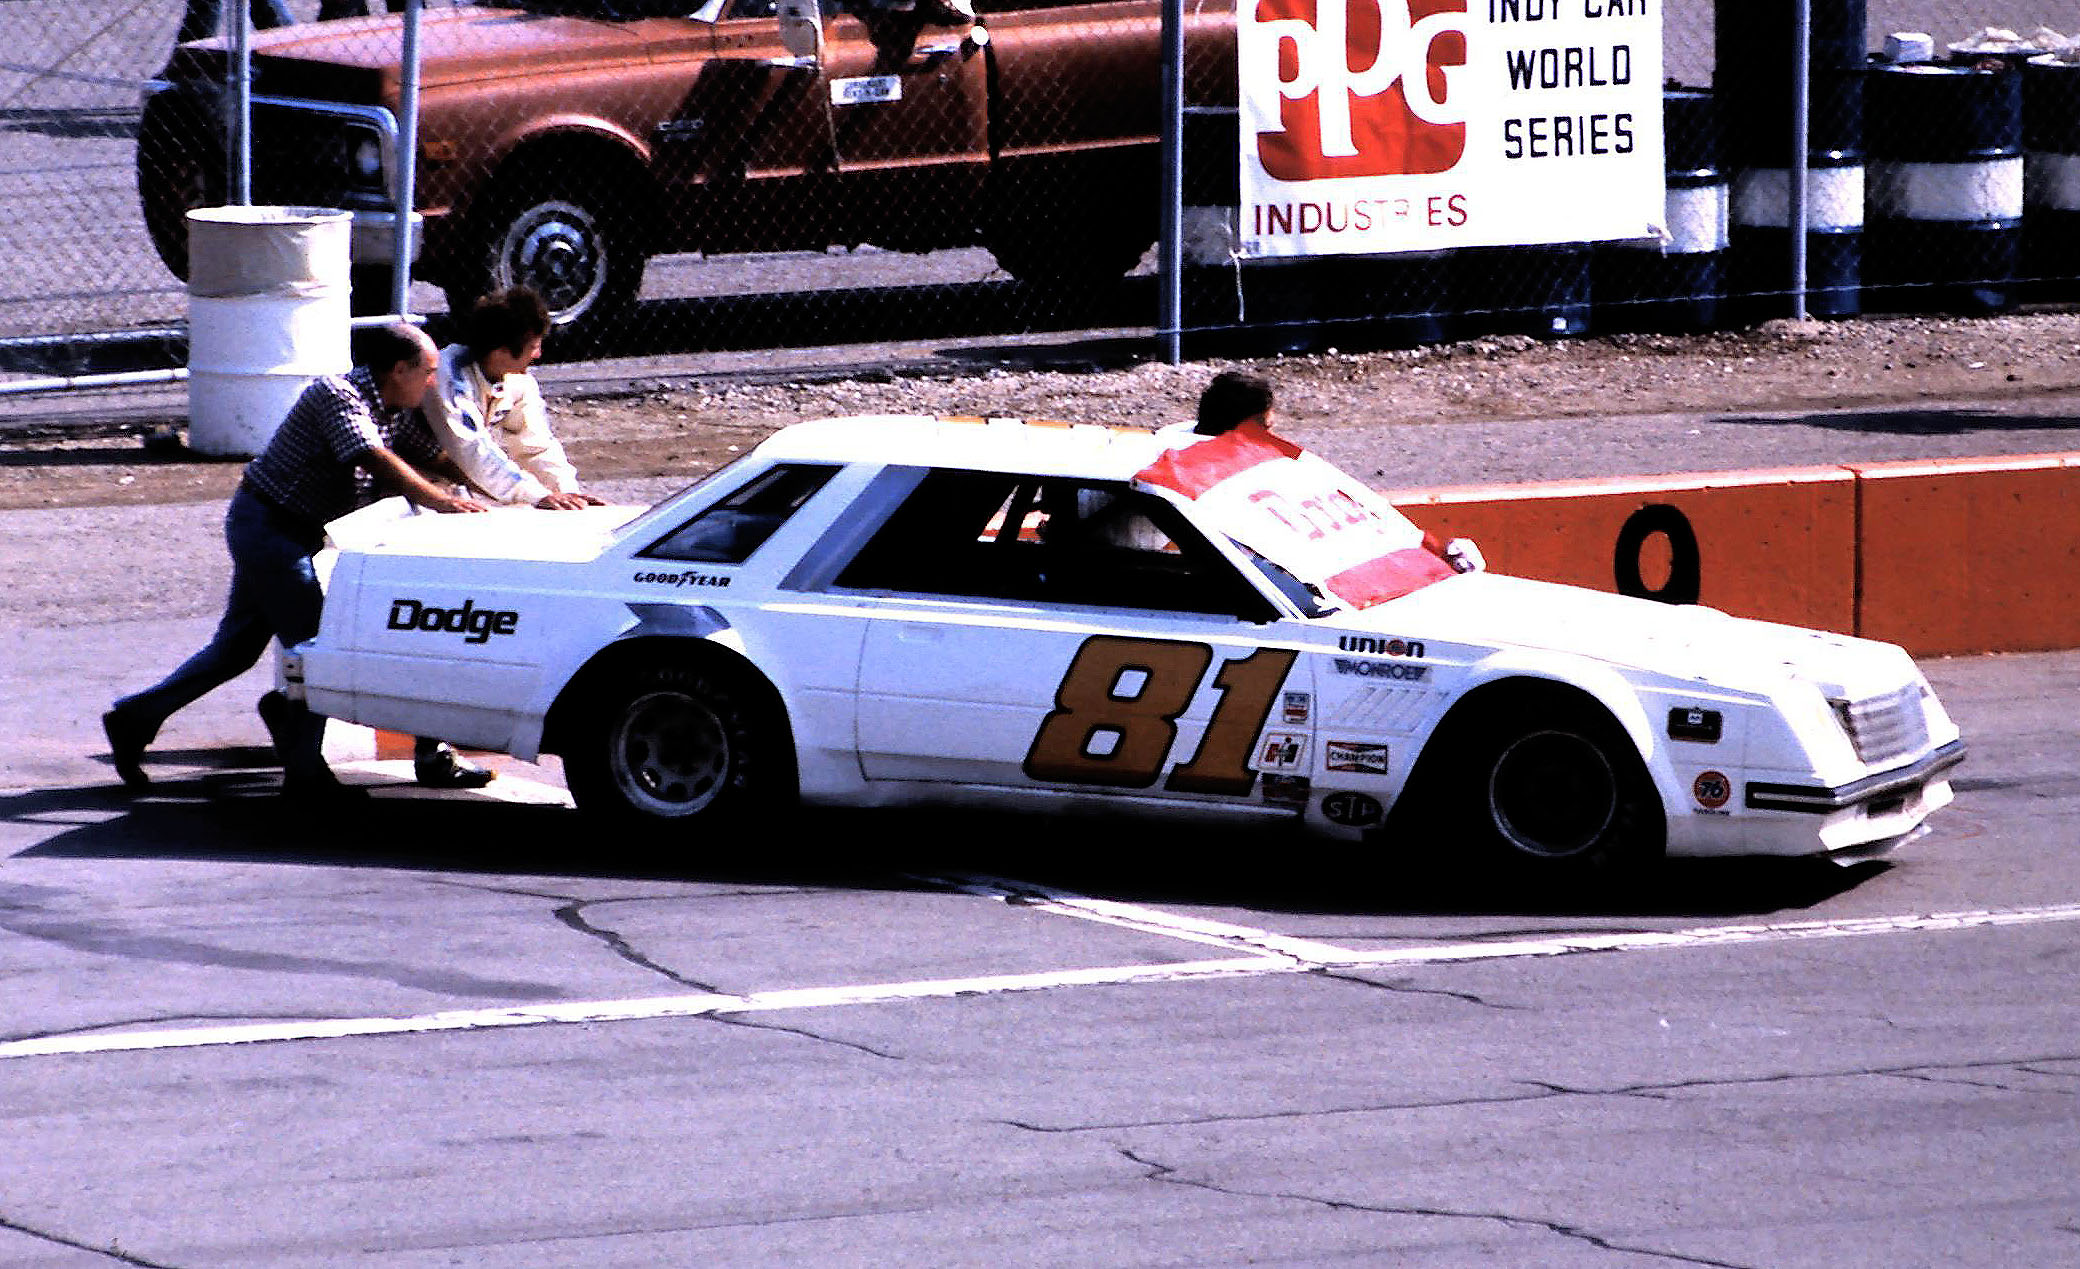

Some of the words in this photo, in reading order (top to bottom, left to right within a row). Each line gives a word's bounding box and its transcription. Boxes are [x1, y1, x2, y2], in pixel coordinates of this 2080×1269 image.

[1506, 45, 1631, 90] WORLD
[1504, 113, 1633, 159] SERIES
[1255, 194, 1467, 235] INDUSTES
[633, 571, 732, 588] GOODYEAR
[387, 599, 519, 643] Dodge
[1023, 634, 1300, 797] 81
[1701, 781, 1724, 799] 76
